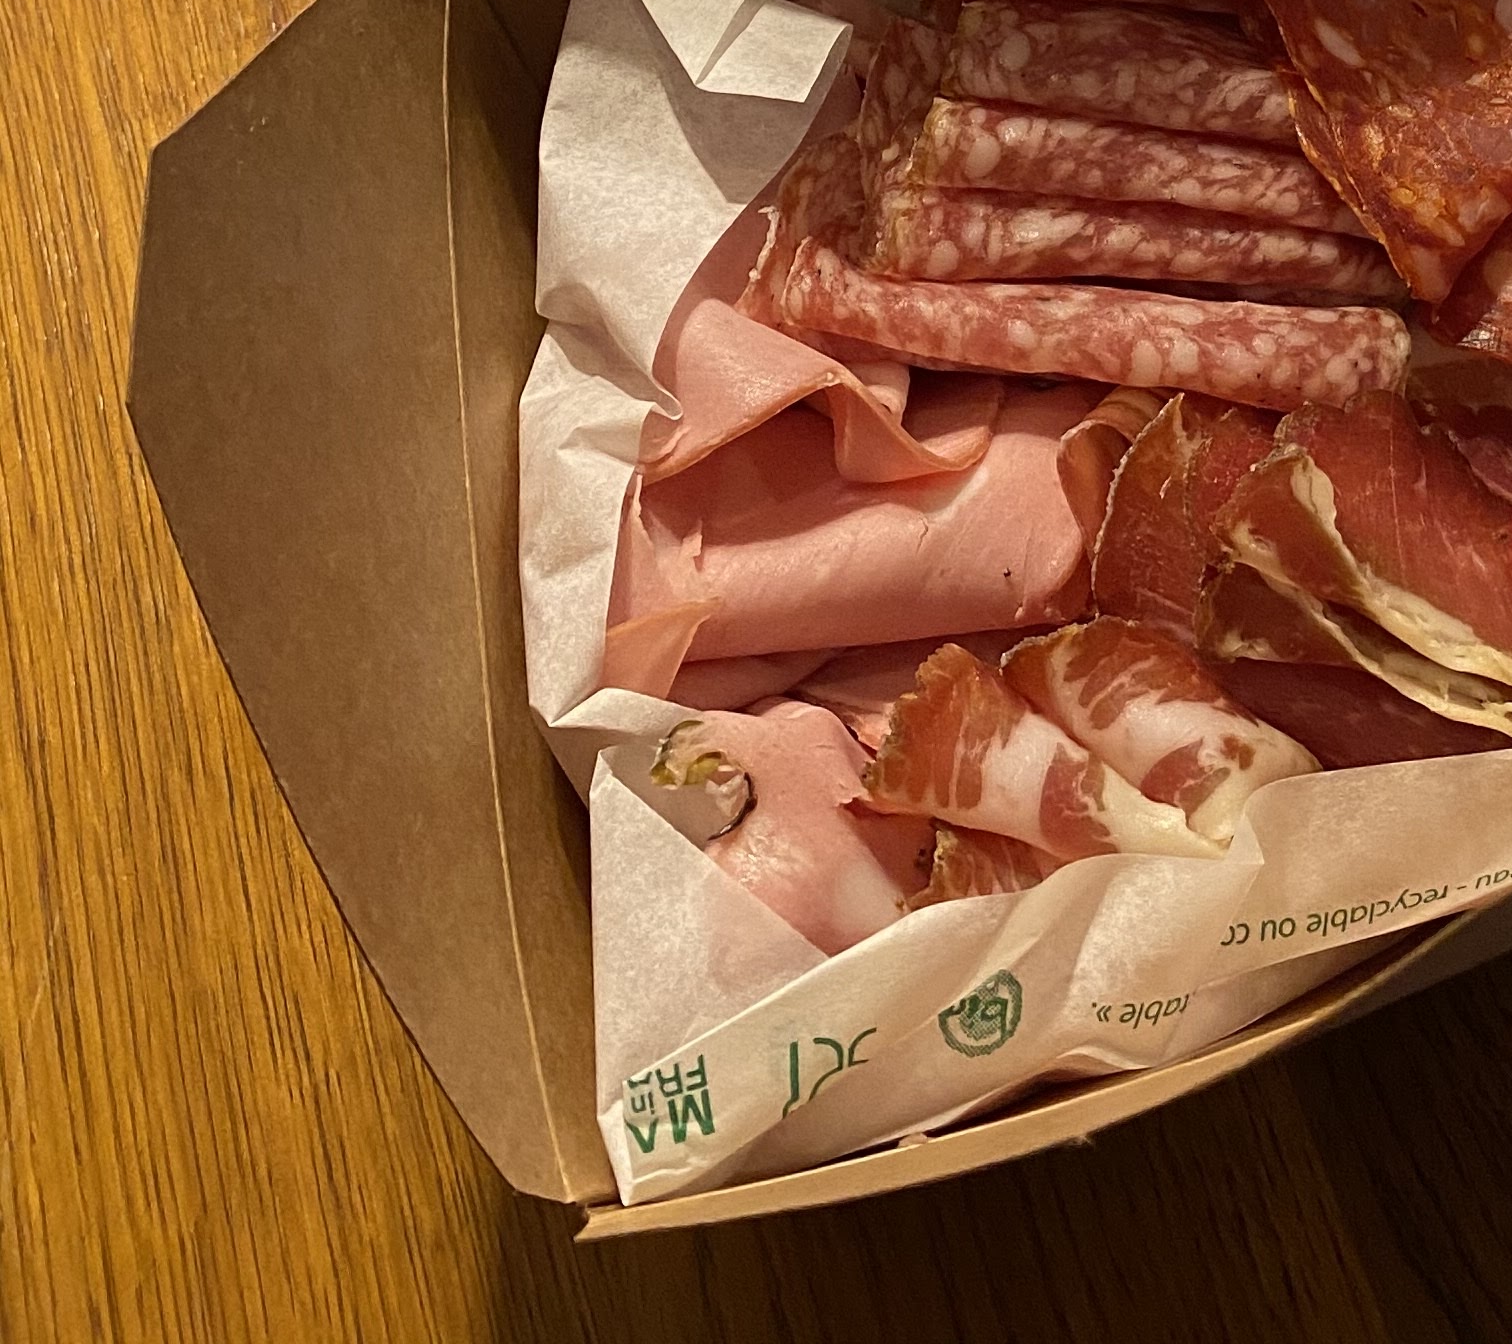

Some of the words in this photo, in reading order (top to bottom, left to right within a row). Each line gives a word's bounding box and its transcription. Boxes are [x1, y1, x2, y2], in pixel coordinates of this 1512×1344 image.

[1306, 885, 1449, 938] recyclable
[1261, 916, 1297, 944] ou
[630, 1091, 656, 1116] in
